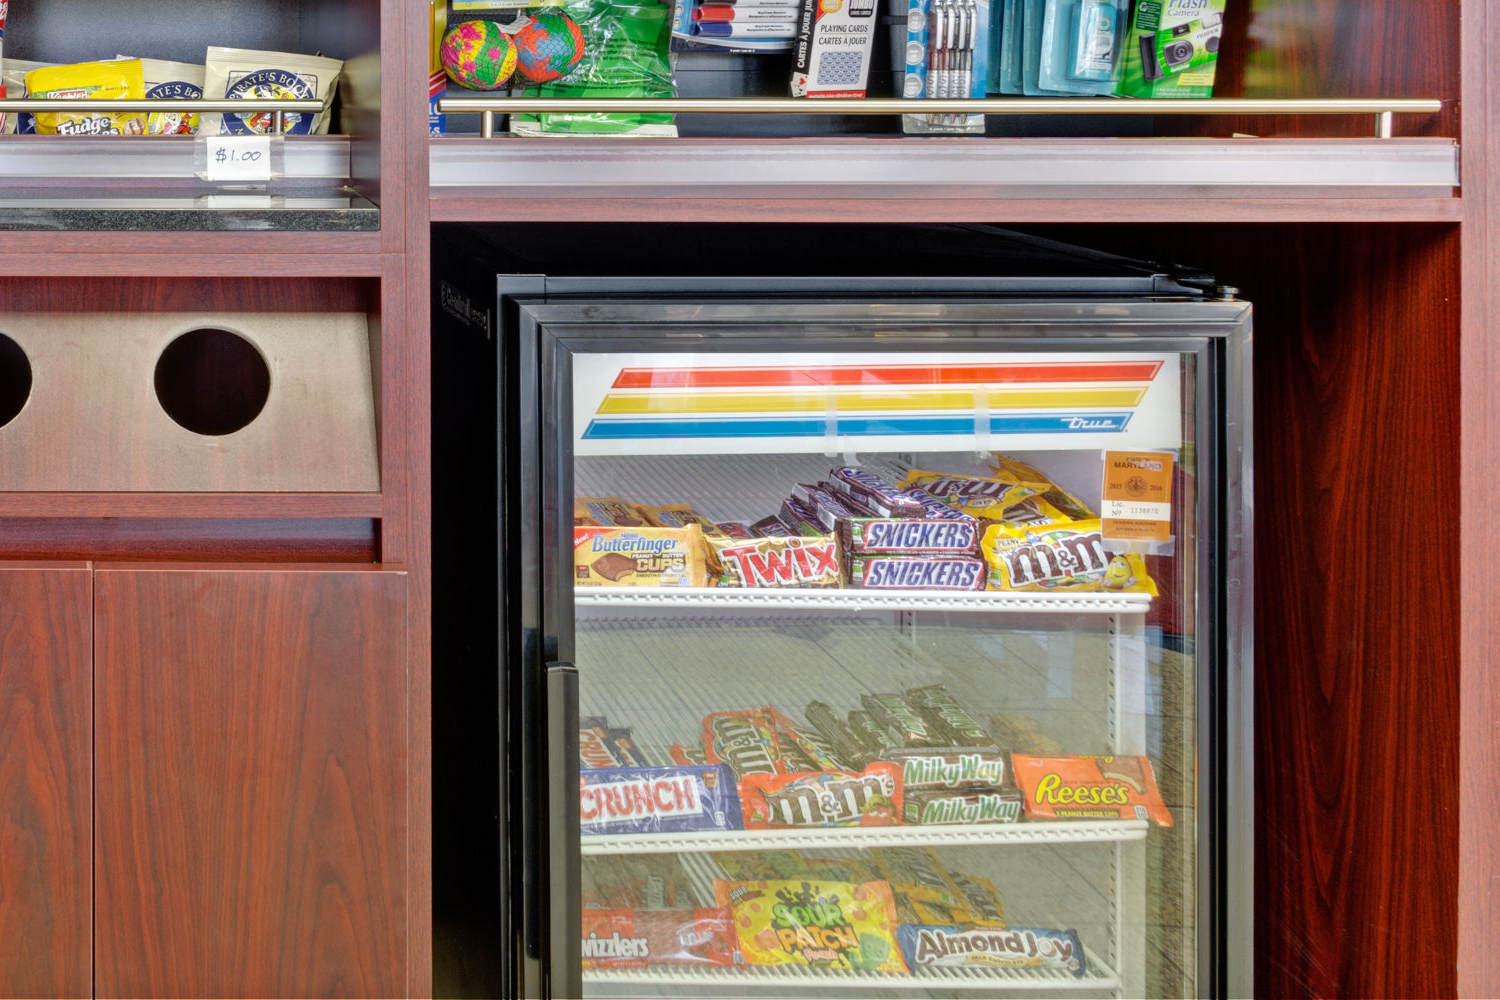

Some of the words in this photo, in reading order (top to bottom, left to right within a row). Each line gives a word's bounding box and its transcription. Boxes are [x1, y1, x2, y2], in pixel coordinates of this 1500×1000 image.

[802, 12, 812, 34] JOUER
[1167, 9, 1200, 17] Camera
[820, 25, 847, 34] PLAYING
[848, 24, 869, 32] CARDS
[818, 36, 842, 45] CARTES
[849, 36, 867, 47] JOUER
[797, 45, 808, 69] CARTES
[1061, 416, 1116, 429] true
[1114, 461, 1162, 470] MARYLAND
[574, 532, 589, 546] New!
[592, 534, 679, 555] Butterfinger
[867, 522, 975, 549] SNICKERS
[636, 557, 686, 574] CUPS
[867, 560, 984, 588] SNICKERS
[580, 776, 697, 820] CRUNCH
[1036, 773, 1130, 806] Reese's
[772, 902, 846, 928] SOUR
[775, 926, 861, 952] PATCH
[916, 928, 1025, 966] Almond
[1024, 930, 1073, 962] Joy
